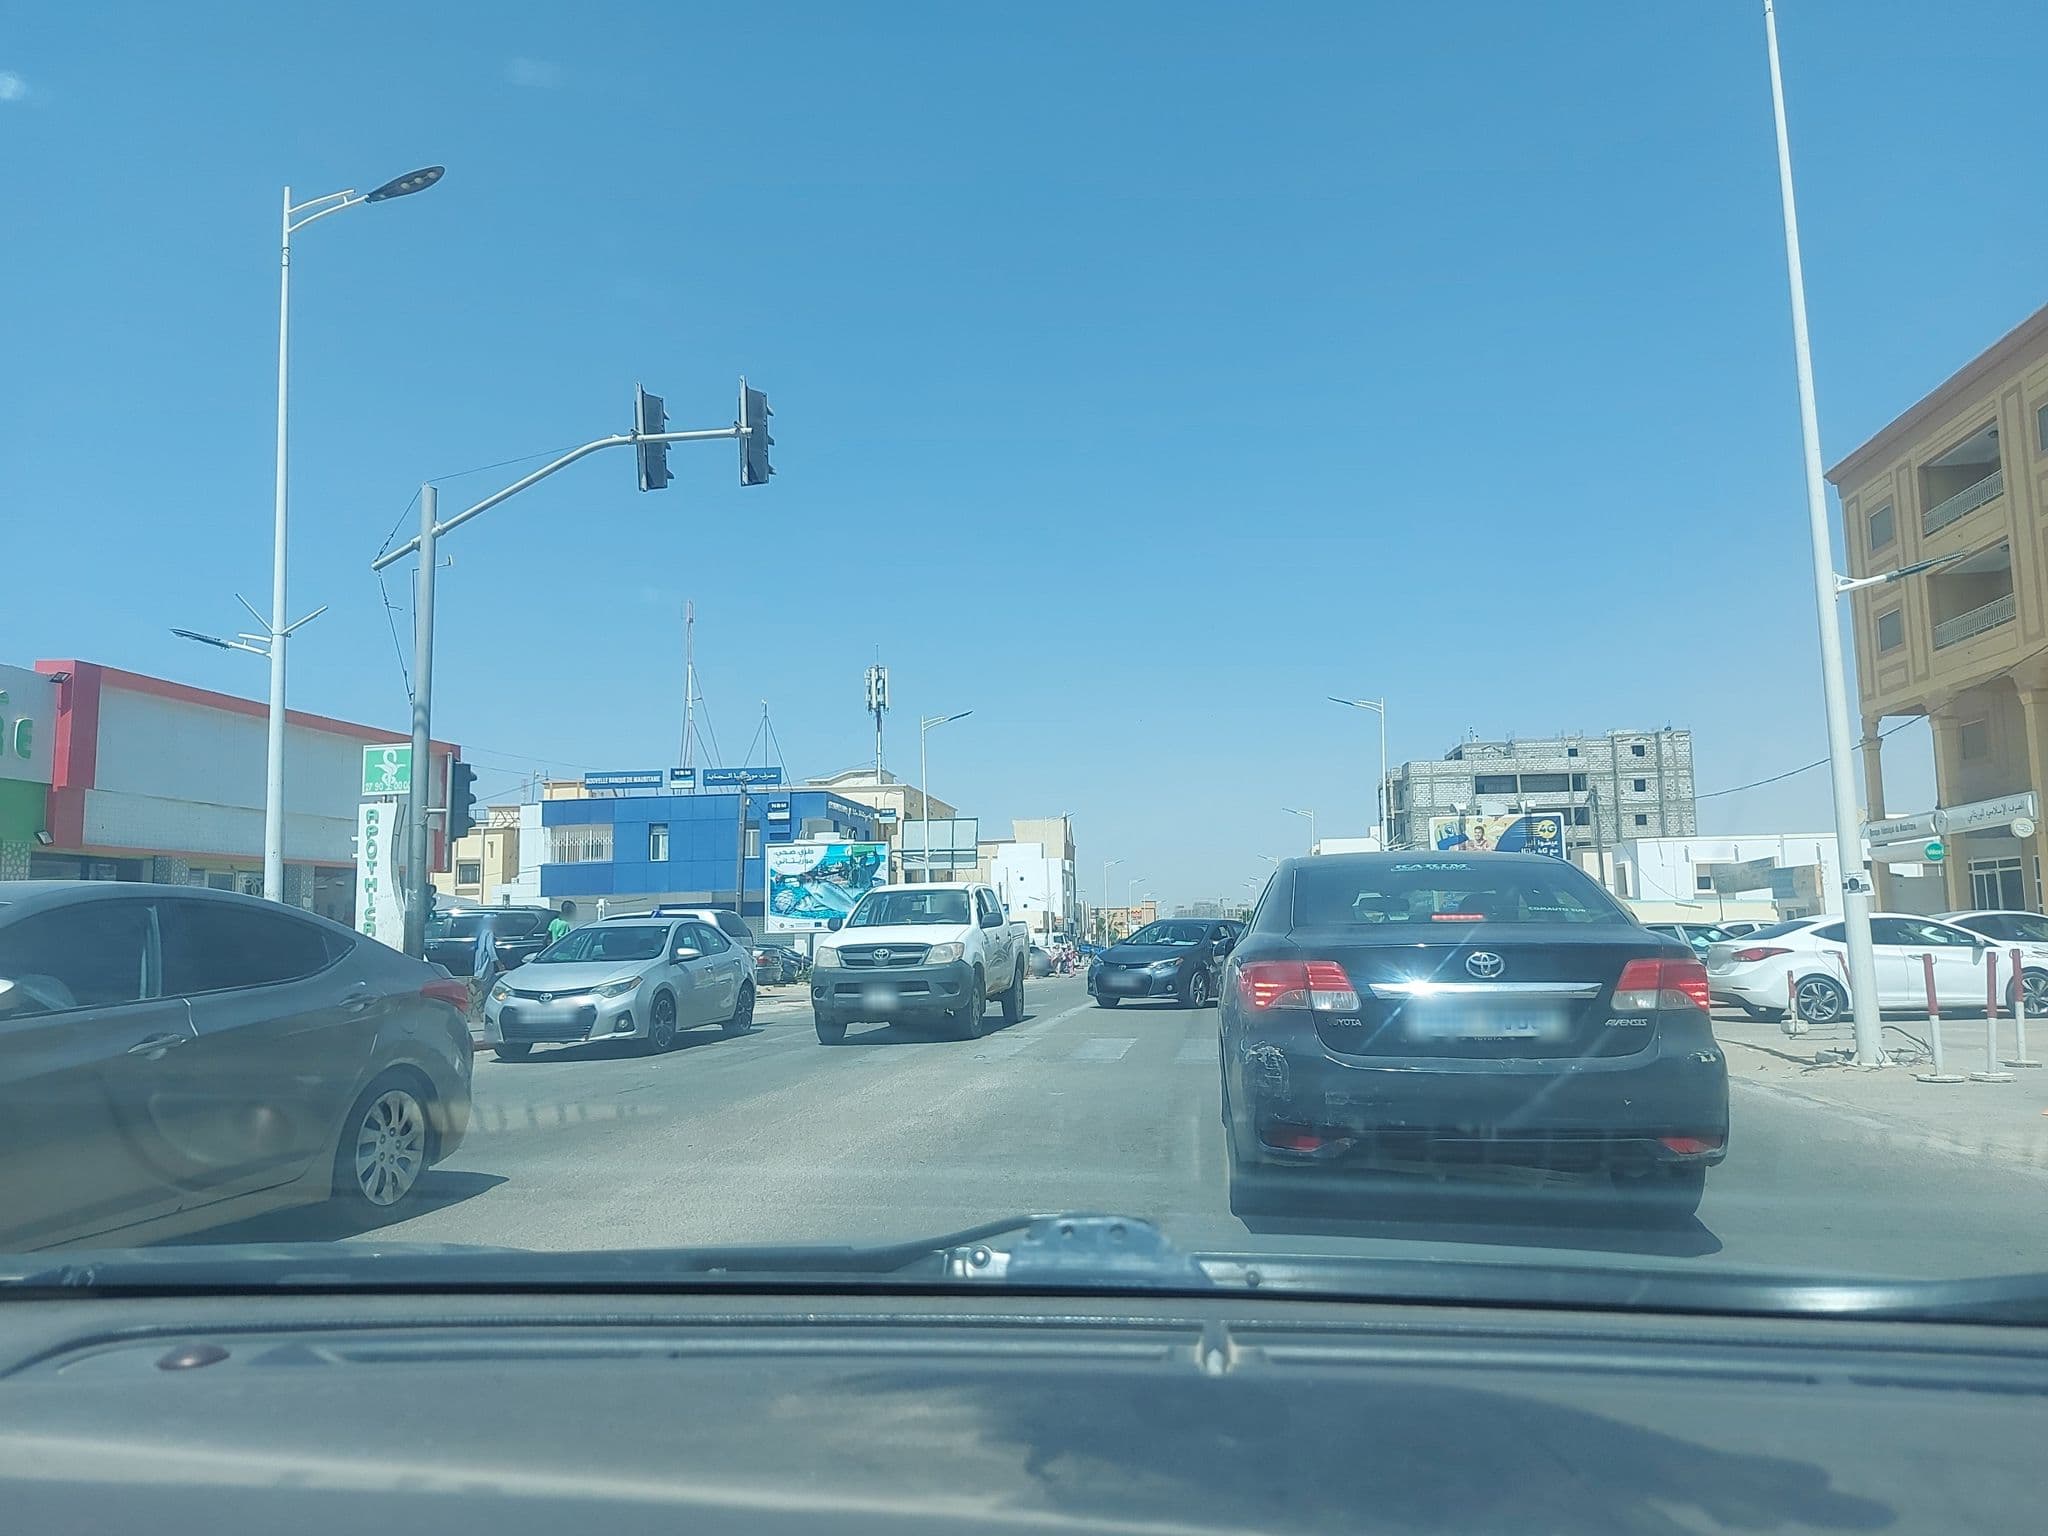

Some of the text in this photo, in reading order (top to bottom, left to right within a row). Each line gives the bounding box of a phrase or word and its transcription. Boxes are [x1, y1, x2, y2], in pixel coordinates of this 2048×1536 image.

[1539, 823, 1557, 834] 4G
[1549, 848, 1559, 856] مع
[1327, 1018, 1362, 1026] YOTA
[1604, 1018, 1648, 1026] AVENSIS
